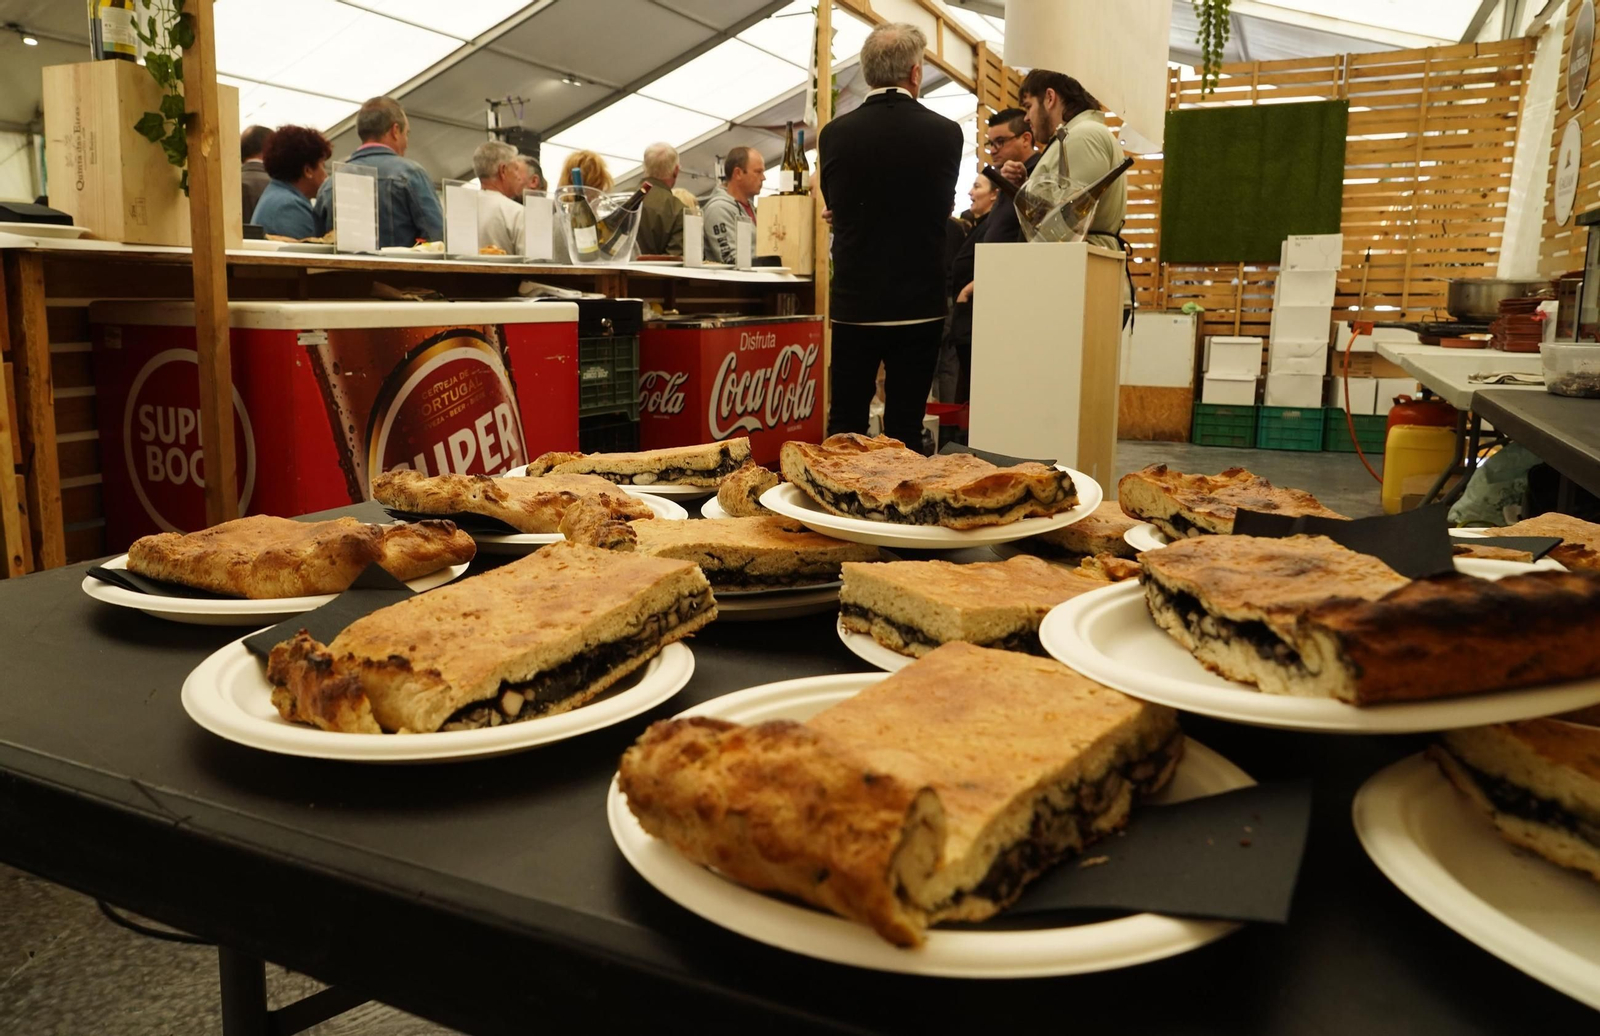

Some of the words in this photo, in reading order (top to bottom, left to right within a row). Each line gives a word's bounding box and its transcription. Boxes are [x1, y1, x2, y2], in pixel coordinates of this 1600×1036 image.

[740, 332, 776, 351] Disfruta
[419, 377, 483, 416] ORTUGAL
[421, 376, 458, 400] CERVEJA
[459, 370, 469, 380] DE
[708, 343, 819, 440] Coca-Cola
[138, 404, 204, 447] SUP
[391, 402, 519, 478] UPER
[146, 445, 205, 487] BOC
